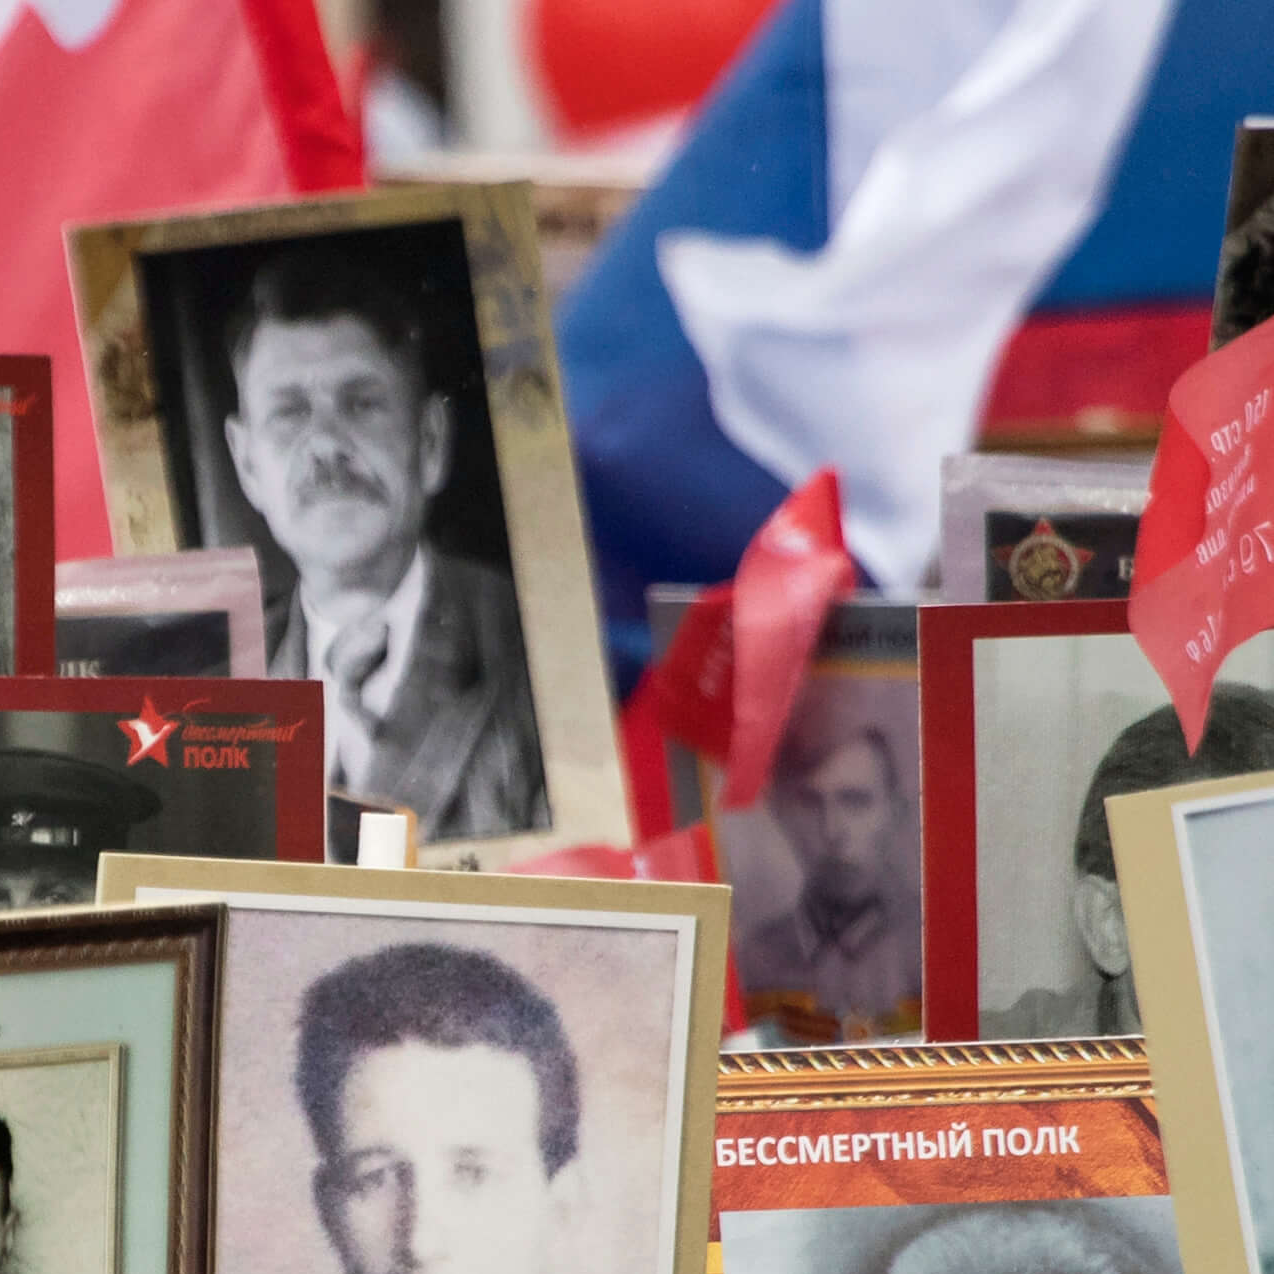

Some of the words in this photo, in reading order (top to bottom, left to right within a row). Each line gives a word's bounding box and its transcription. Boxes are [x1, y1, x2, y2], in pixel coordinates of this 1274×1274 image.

[182, 745, 250, 769] ПОЛК
[715, 1121, 975, 1168] БЕССМЕРТНЫЙ
[982, 1125, 1080, 1157] ПОЛК
